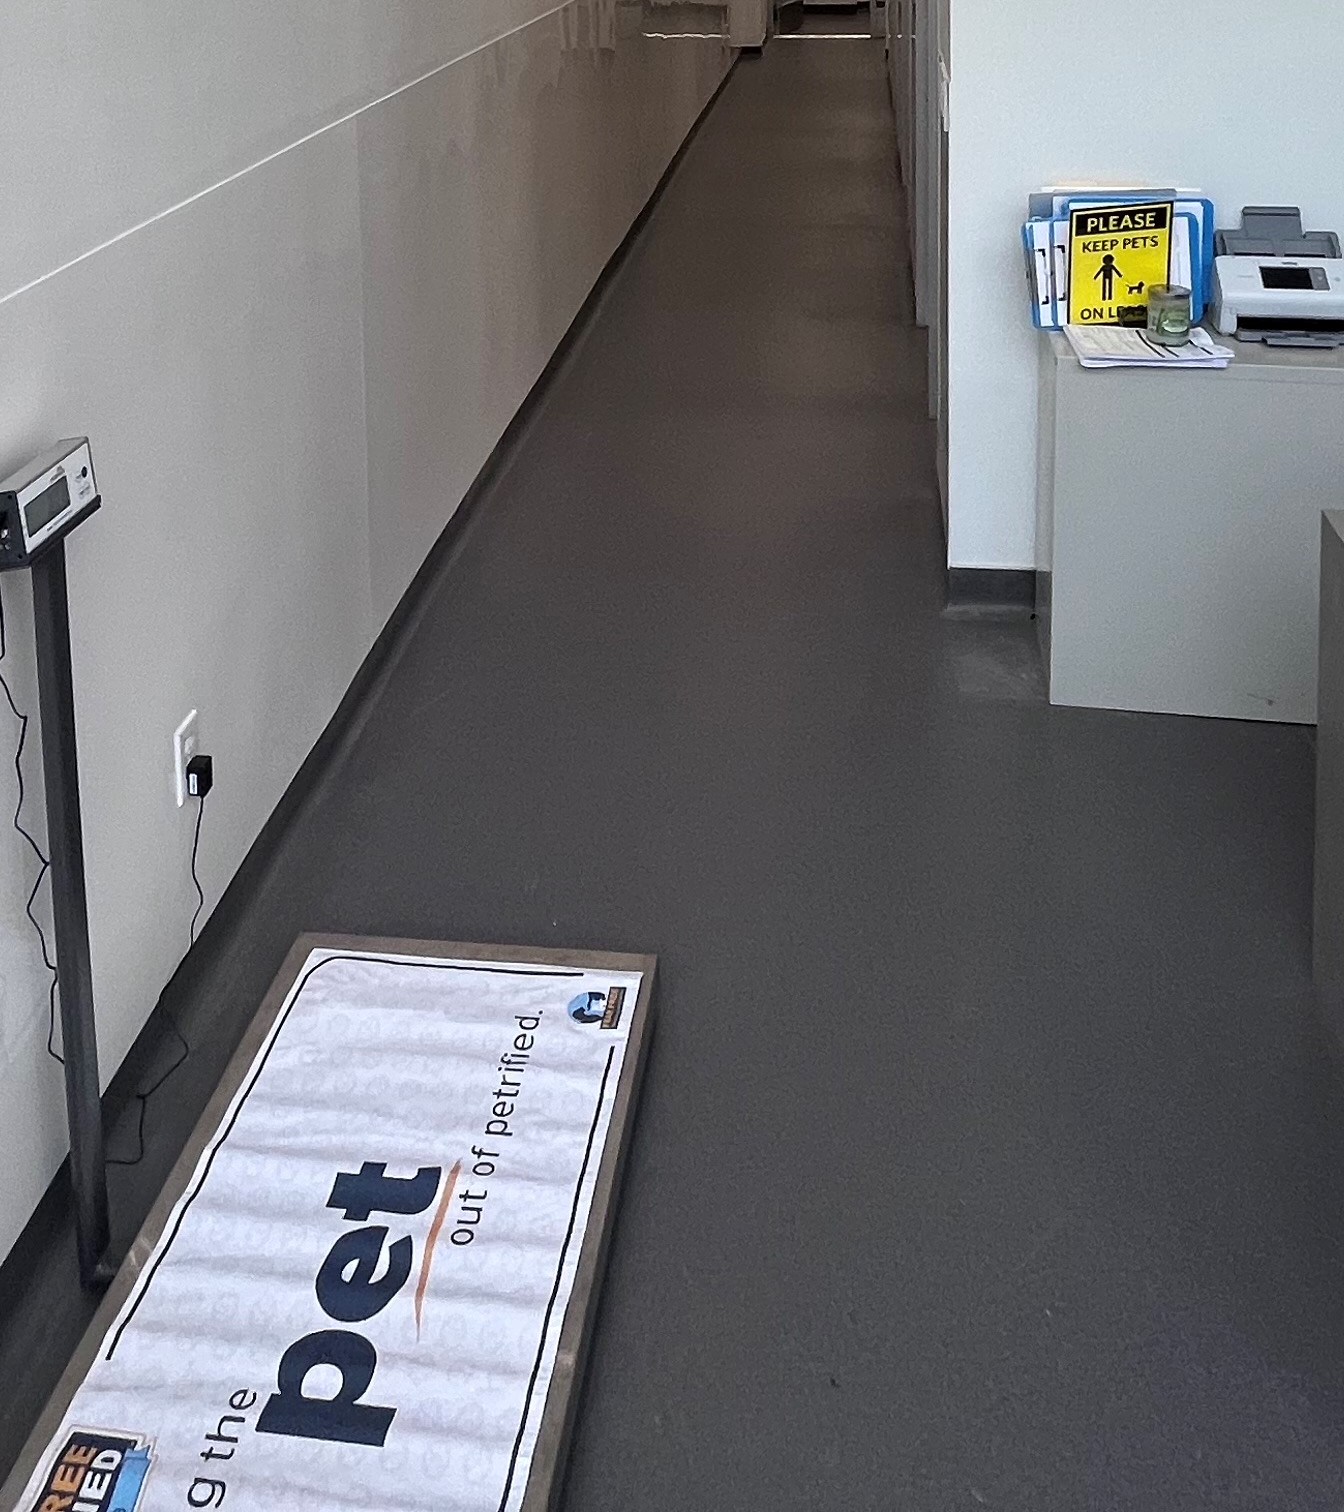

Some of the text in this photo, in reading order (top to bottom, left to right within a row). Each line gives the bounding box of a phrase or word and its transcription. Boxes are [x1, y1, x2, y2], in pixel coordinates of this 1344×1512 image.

[1082, 236, 1159, 253] KEEP PETS
[1087, 212, 1156, 233] PLEASE
[1080, 307, 1104, 320] ON
[450, 1010, 543, 1246] out of petrified.
[255, 1161, 442, 1448] pet
[200, 1387, 257, 1461] the
[36, 1444, 98, 1512] REE
